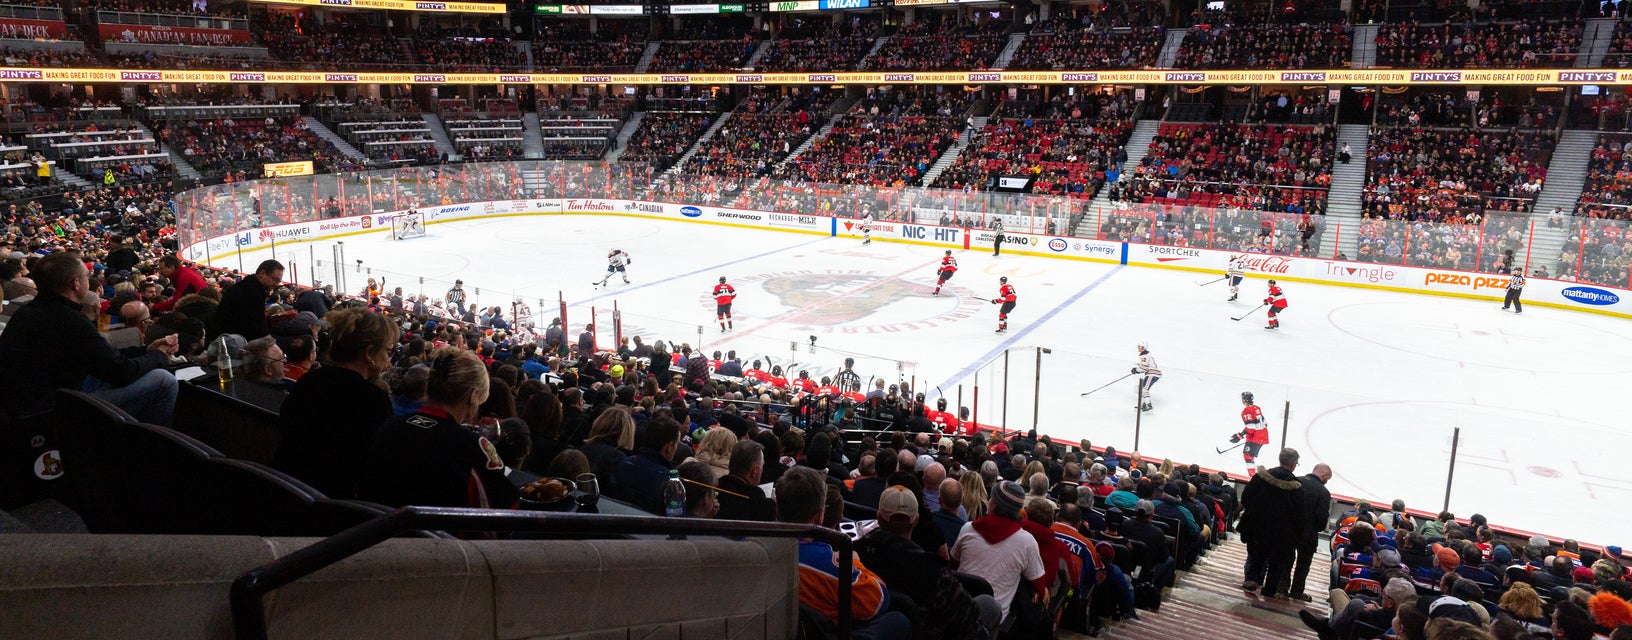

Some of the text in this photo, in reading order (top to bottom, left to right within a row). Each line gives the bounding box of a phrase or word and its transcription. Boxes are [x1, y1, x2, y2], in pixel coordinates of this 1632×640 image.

[777, 2, 798, 11] MNP
[0, 24, 49, 37] AN DECK
[1, 71, 41, 79] PINTY'S
[123, 72, 160, 80] PINTY'S
[1283, 73, 1325, 81] PINTY'S
[1413, 73, 1460, 81] PINTY'S
[1465, 73, 1550, 81] MAKING GREAT FOOD FUN
[1560, 73, 1615, 81] PINTY'S
[440, 205, 470, 214] BOEING
[567, 199, 615, 211] Tim Hortons
[639, 204, 664, 213] CANADIAN
[769, 213, 793, 222] RECHARGE
[798, 216, 817, 225] MILK
[276, 227, 310, 238] HUAWEI
[902, 224, 959, 243] NIC HIT
[234, 232, 252, 247] Bell
[1001, 235, 1028, 245] ASINO
[1051, 241, 1065, 249] Esso
[1084, 244, 1115, 255] Synergy
[1425, 272, 1510, 291] pizza pizz
